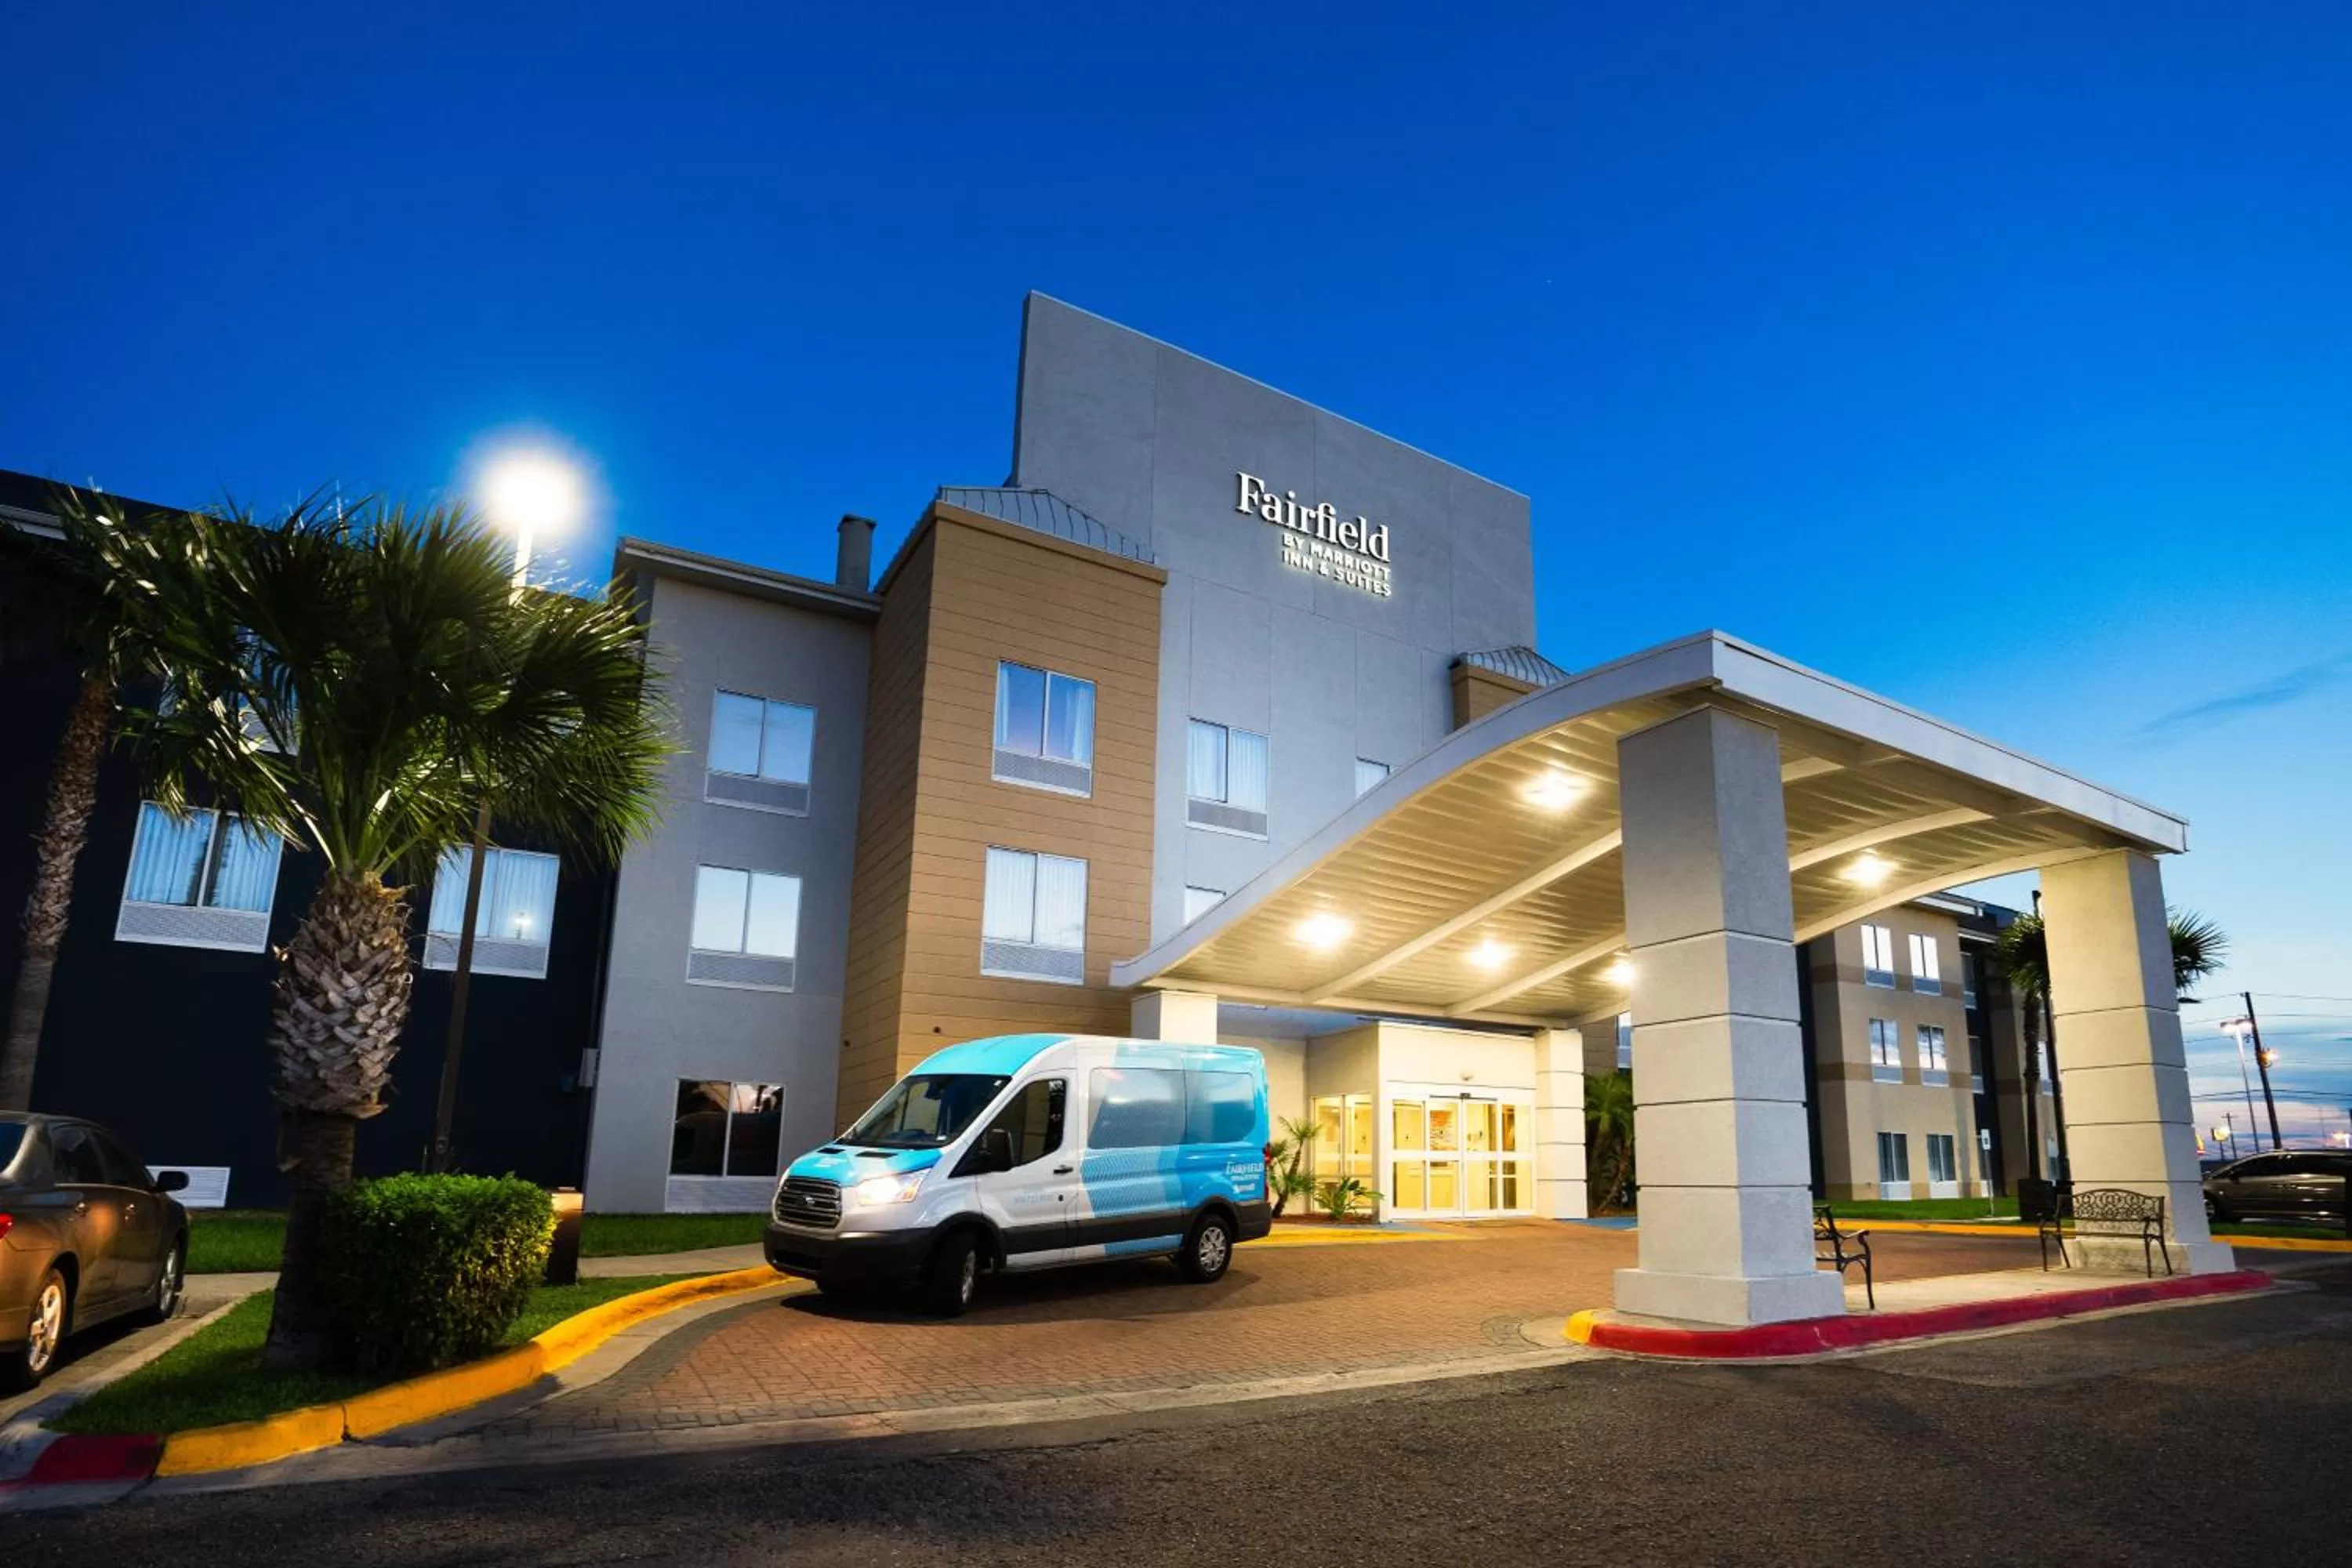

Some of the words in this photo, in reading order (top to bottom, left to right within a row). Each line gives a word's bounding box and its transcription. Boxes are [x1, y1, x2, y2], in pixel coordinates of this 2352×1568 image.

[1235, 471, 1390, 562] Fairfield
[1282, 550, 1313, 571] INN
[1318, 564, 1330, 576] &
[1334, 568, 1392, 597] SUITES
[1283, 533, 1305, 550] BY
[1311, 542, 1392, 580] MARRIOTT
